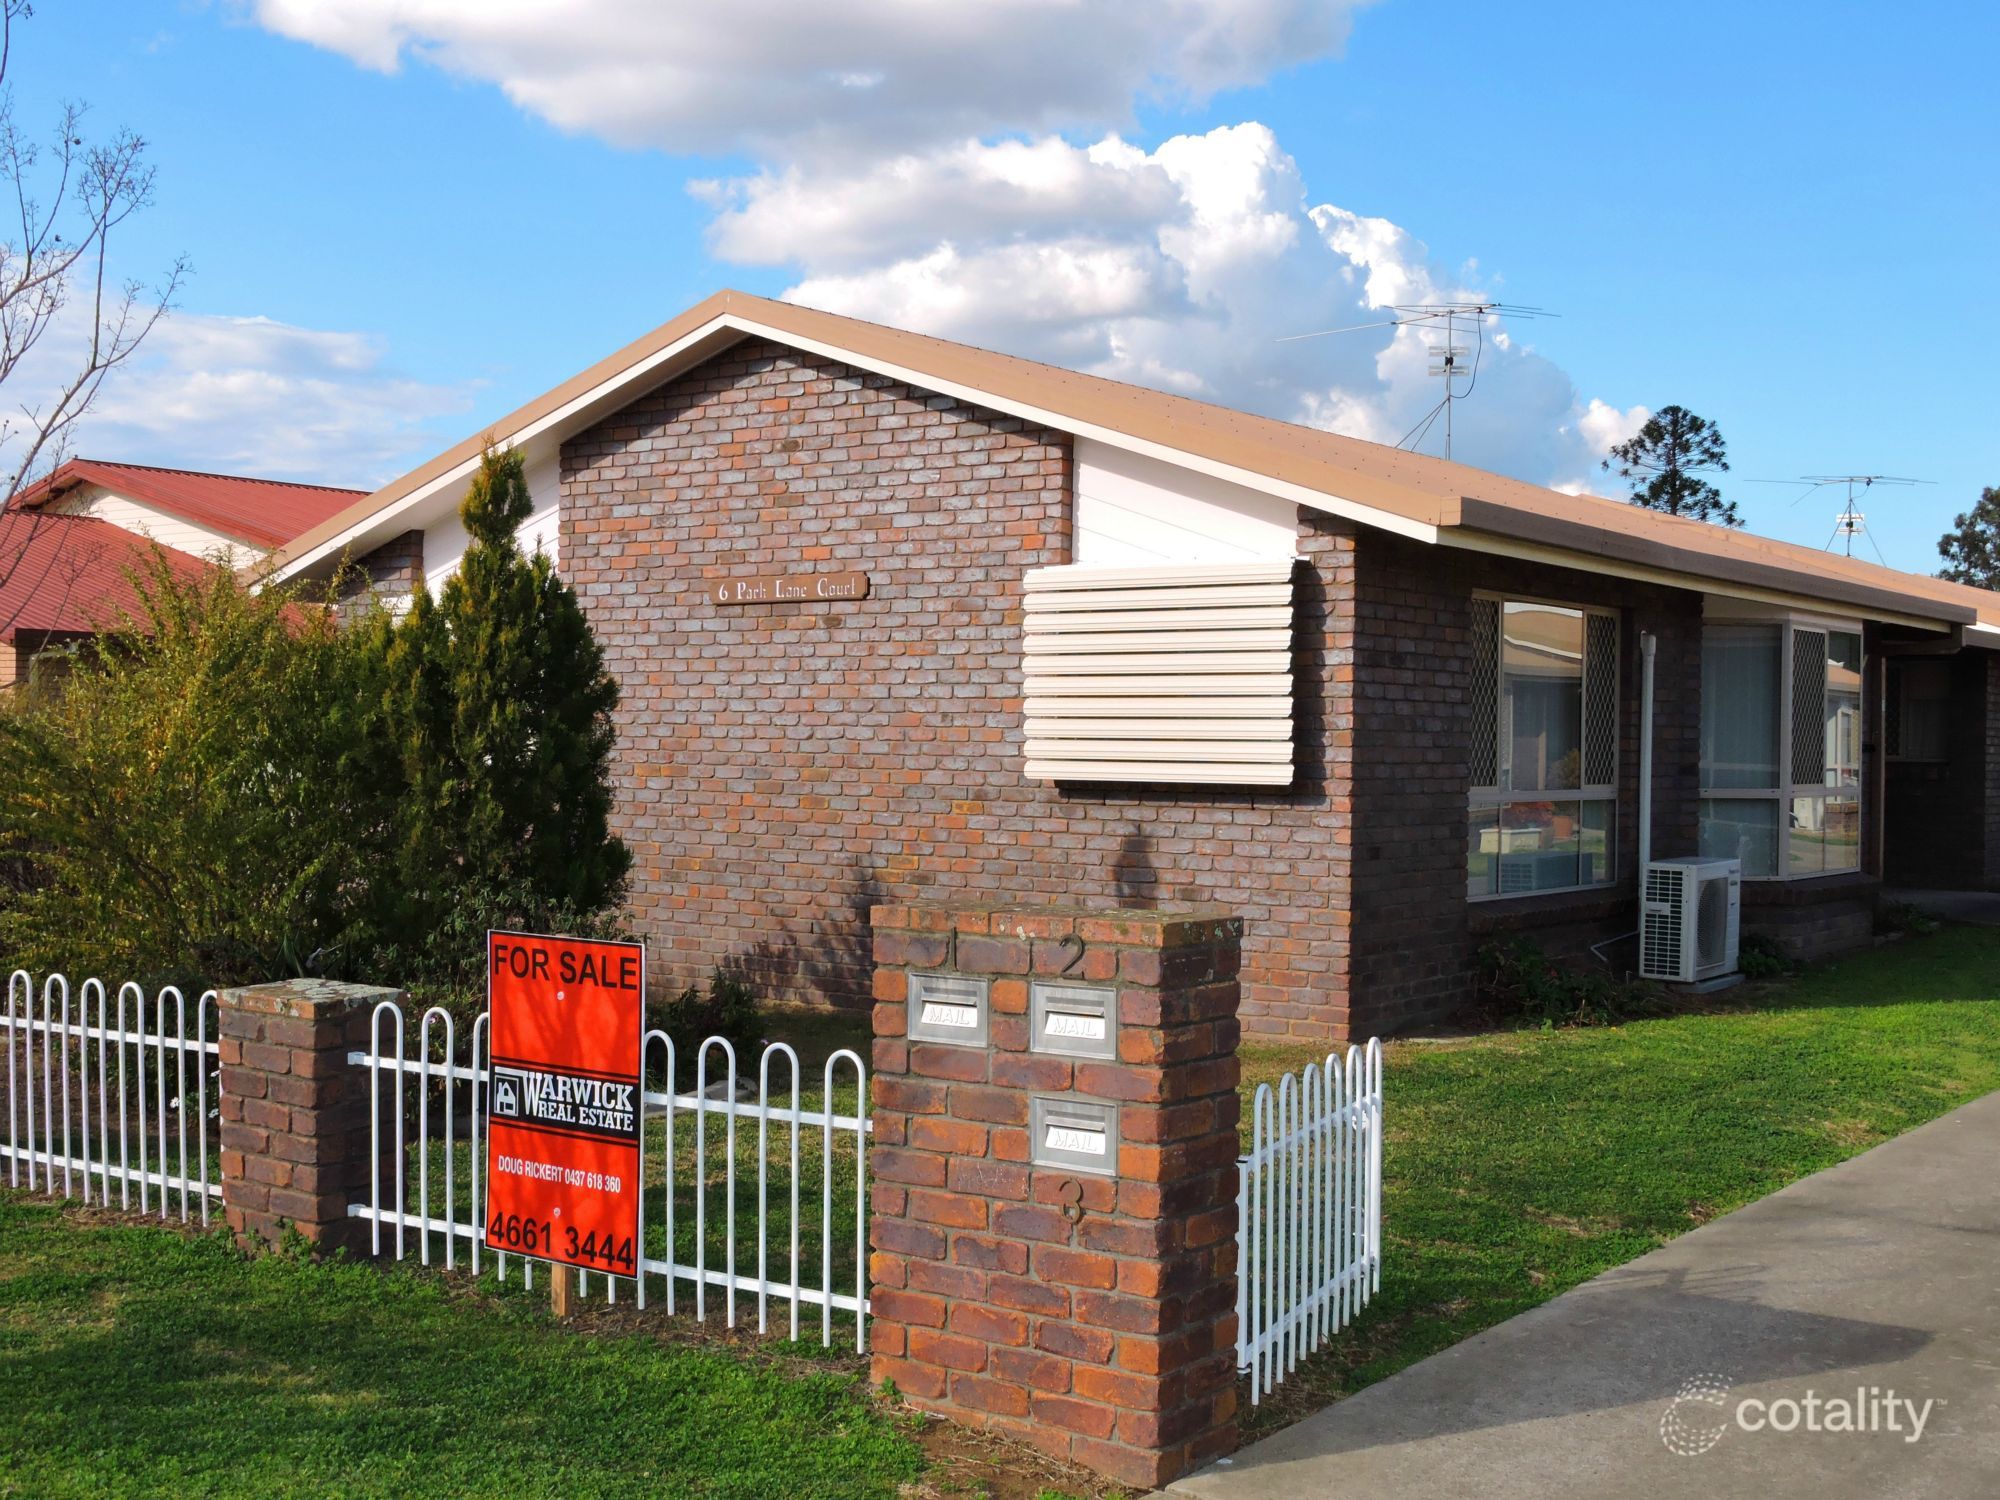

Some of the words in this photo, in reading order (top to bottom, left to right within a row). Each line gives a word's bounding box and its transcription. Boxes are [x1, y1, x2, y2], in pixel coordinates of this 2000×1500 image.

[719, 583, 728, 600] 6
[775, 579, 807, 598] Lane
[817, 577, 855, 597] Court
[494, 944, 549, 981] FOR
[559, 950, 637, 990] SALE
[1059, 933, 1085, 979] 2
[928, 1006, 969, 1025] MAIL
[1052, 1016, 1097, 1036] MAIL
[522, 1071, 633, 1116] WARWICK
[538, 1101, 575, 1123] REAL
[578, 1109, 633, 1131] ESTATE
[1053, 1131, 1097, 1151] MAIL
[498, 1155, 523, 1175] DOUG
[525, 1160, 563, 1183] RICKERT
[564, 1167, 585, 1187] 0437
[587, 1173, 603, 1190] 618
[605, 1175, 621, 1193] 360
[1059, 1178, 1083, 1223] 3
[489, 1211, 551, 1253] 4661
[564, 1226, 634, 1270] 3444
